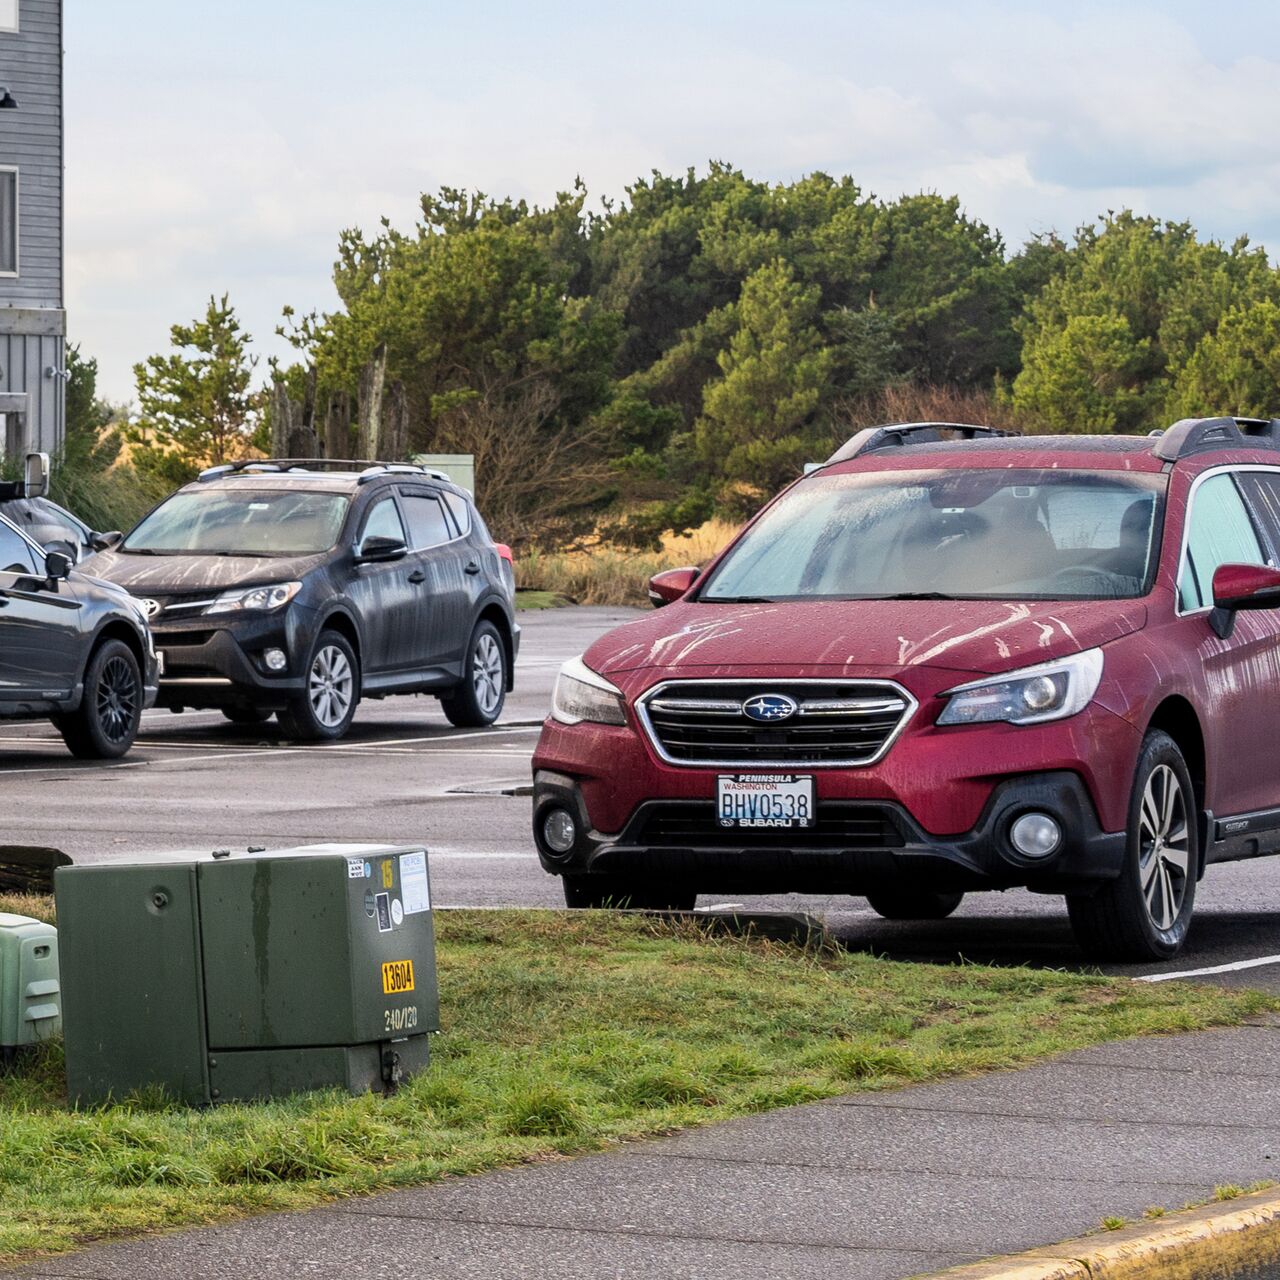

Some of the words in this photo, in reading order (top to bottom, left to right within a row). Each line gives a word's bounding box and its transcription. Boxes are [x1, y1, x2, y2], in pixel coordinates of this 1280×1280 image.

[723, 783, 777, 791] WASHINGTON
[738, 774, 792, 783] PENINSULA
[722, 793, 808, 818] BHV0538
[739, 818, 793, 827] SUBARU
[381, 859, 393, 889] 15
[383, 961, 412, 992] 13604
[384, 1006, 418, 1032] 240/120
